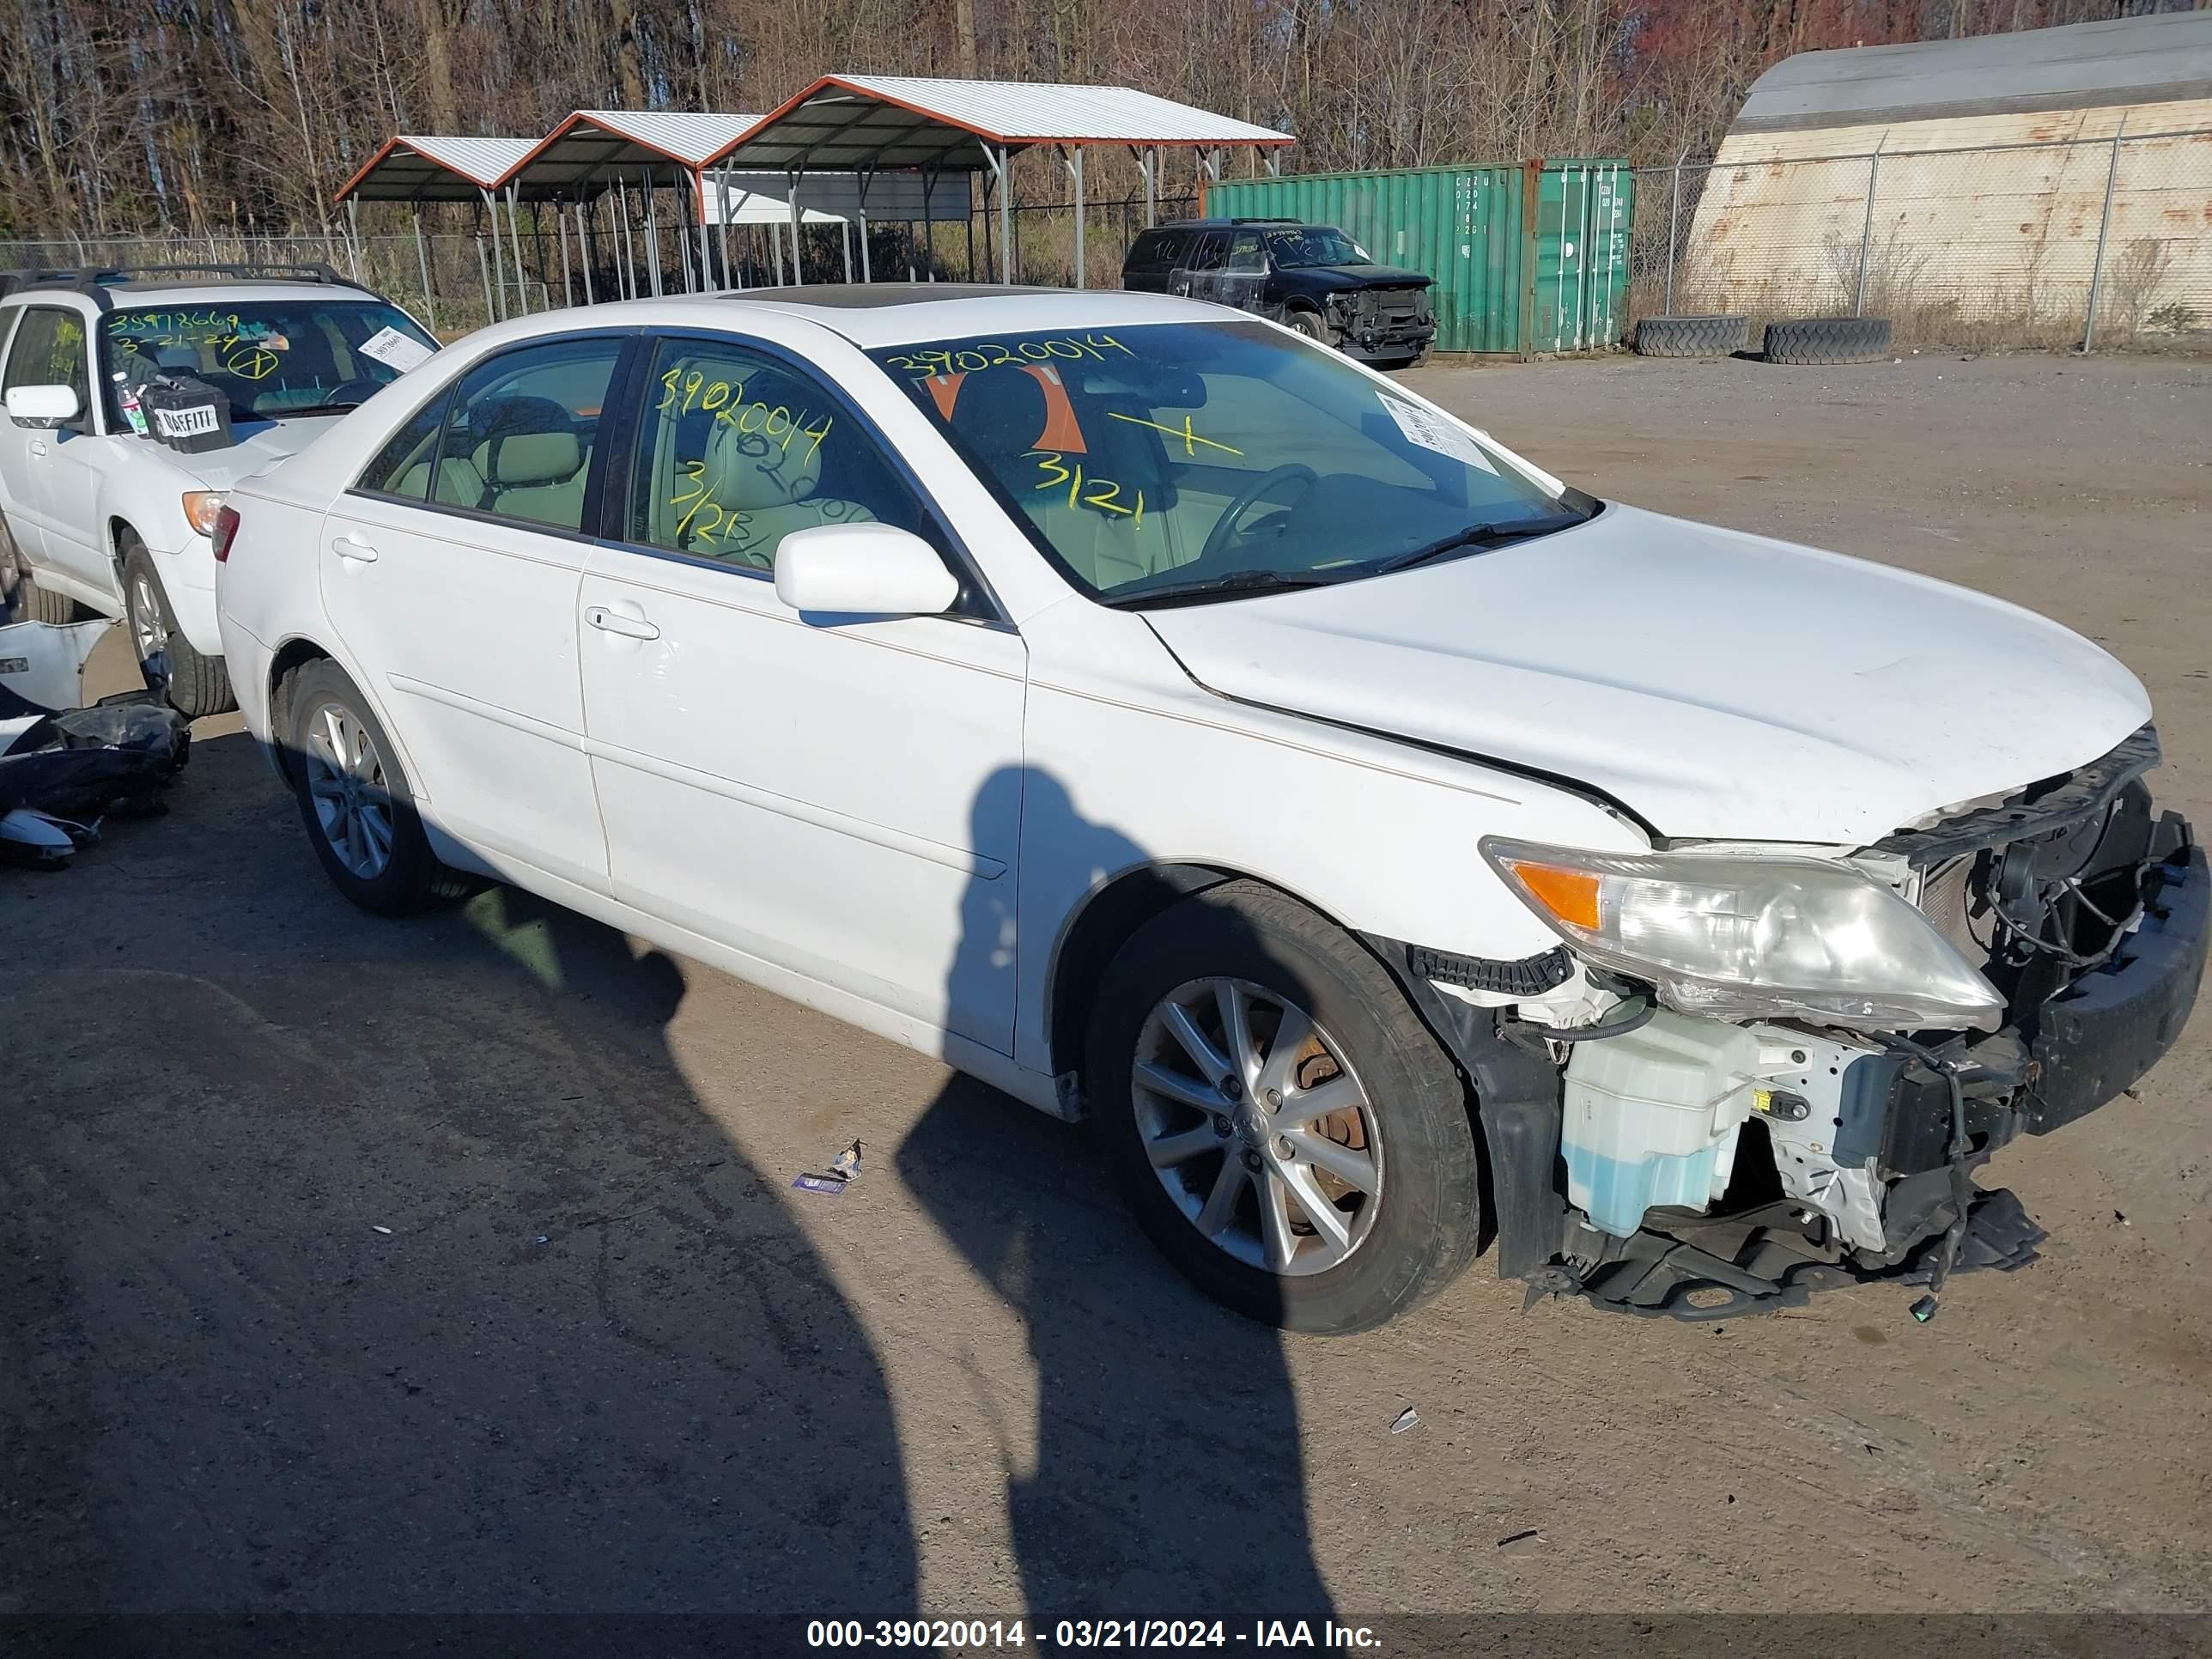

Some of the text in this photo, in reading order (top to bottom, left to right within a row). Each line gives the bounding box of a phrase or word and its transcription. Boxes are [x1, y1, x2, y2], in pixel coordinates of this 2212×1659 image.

[108, 311, 239, 336] 38978669
[118, 333, 240, 356] 3-21-24
[373, 335, 404, 357] 38978669
[886, 333, 1137, 380] 39020014
[655, 368, 833, 468] 39020014
[670, 460, 741, 546] 3/21
[1019, 451, 1145, 532] 3/21
